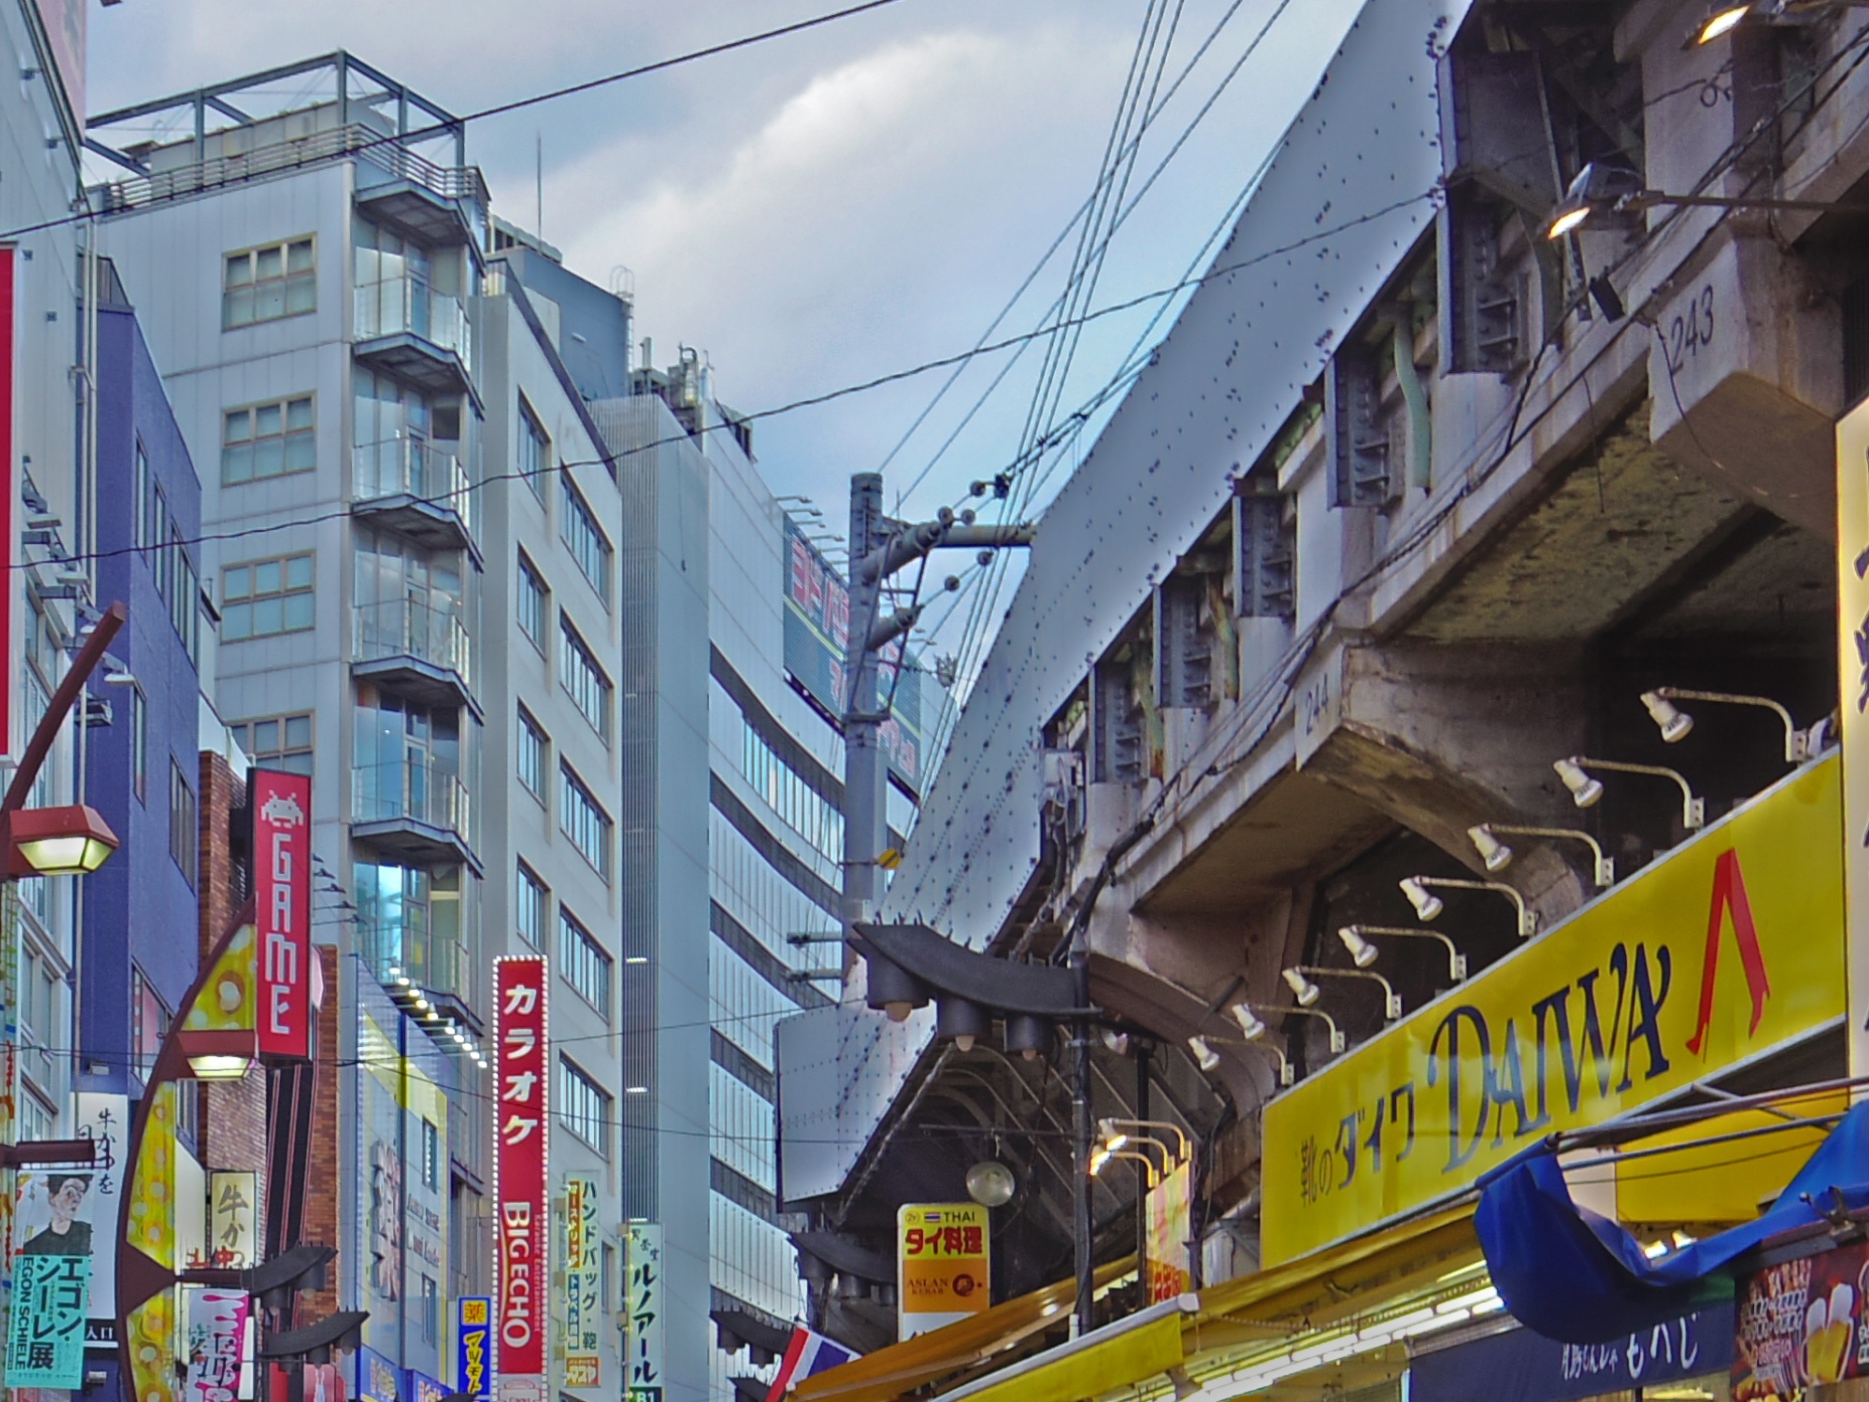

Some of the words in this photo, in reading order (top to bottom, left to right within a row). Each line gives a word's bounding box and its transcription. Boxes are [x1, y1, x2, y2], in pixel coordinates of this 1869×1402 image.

[1671, 284, 1714, 375] 243
[265, 832, 298, 1035] GAME
[503, 984, 538, 1146] カラオケ
[1427, 942, 1673, 1175] DAIWA
[503, 1201, 531, 1258] BIG
[905, 1226, 983, 1256] タイ料理
[944, 1211, 976, 1223] THAI
[19, 1257, 34, 1303] EGON
[27, 1256, 61, 1371] シーレ展
[503, 1263, 531, 1348] ECHO
[15, 1305, 31, 1371] SCHIELE
[85, 1326, 115, 1341] 入口
[632, 1262, 657, 1384] ルノアール
